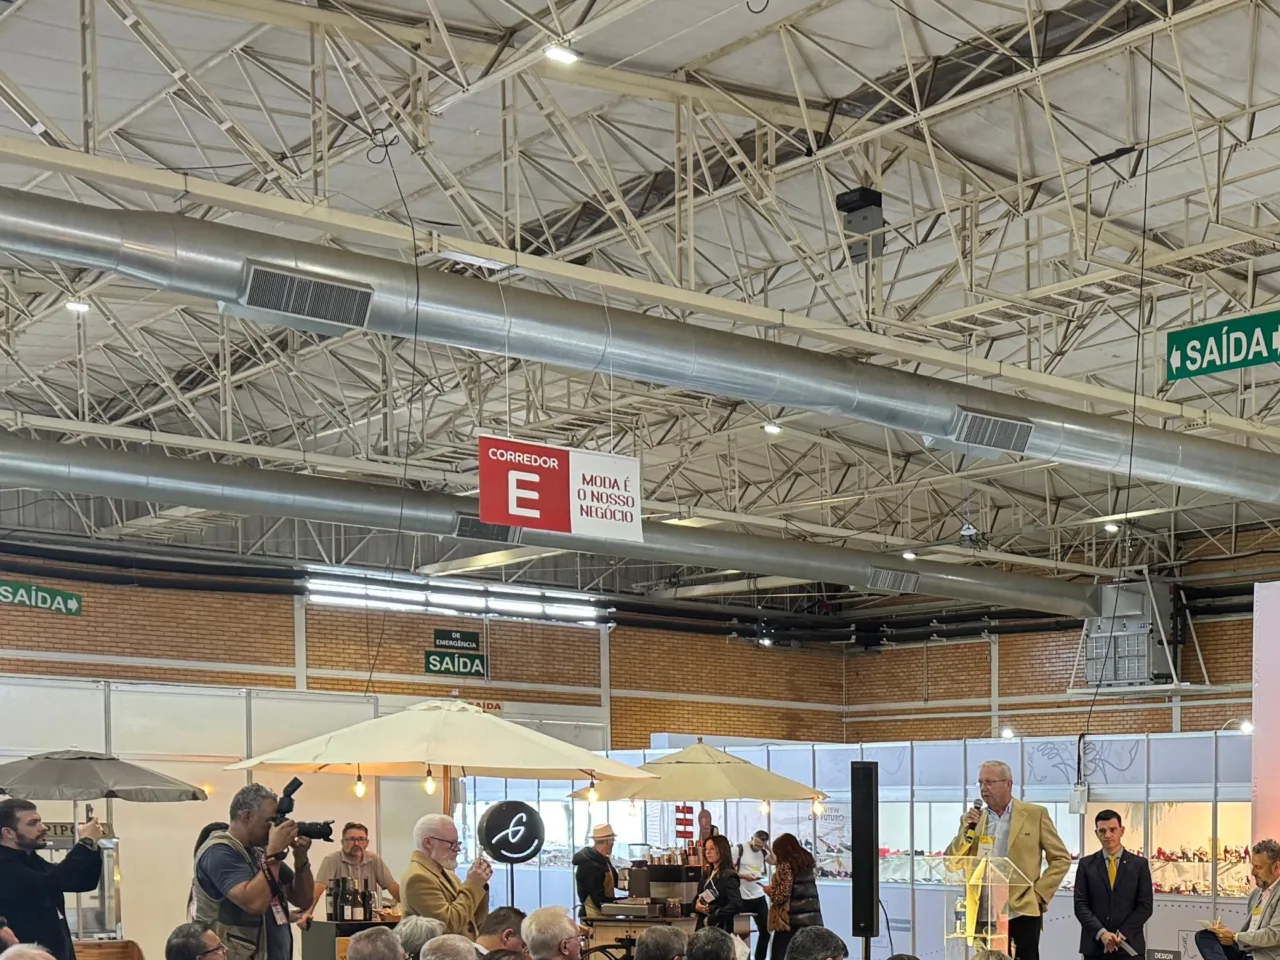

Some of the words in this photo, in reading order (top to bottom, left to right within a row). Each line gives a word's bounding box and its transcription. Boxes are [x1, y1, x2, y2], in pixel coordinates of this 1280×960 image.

[1186, 326, 1269, 371] SAÍDA
[488, 448, 559, 470] CORREDOR
[582, 473, 620, 491] MODA
[624, 476, 631, 492] É
[508, 470, 541, 518] E
[577, 488, 587, 501] O
[591, 490, 635, 508] NOSSO
[580, 504, 634, 523] NEGÓCIO
[0, 586, 67, 613] SAÍDA
[436, 639, 477, 648] EMERGÊNCIA
[429, 654, 484, 674] SAÍDA
[1154, 952, 1174, 960] DESIGN
